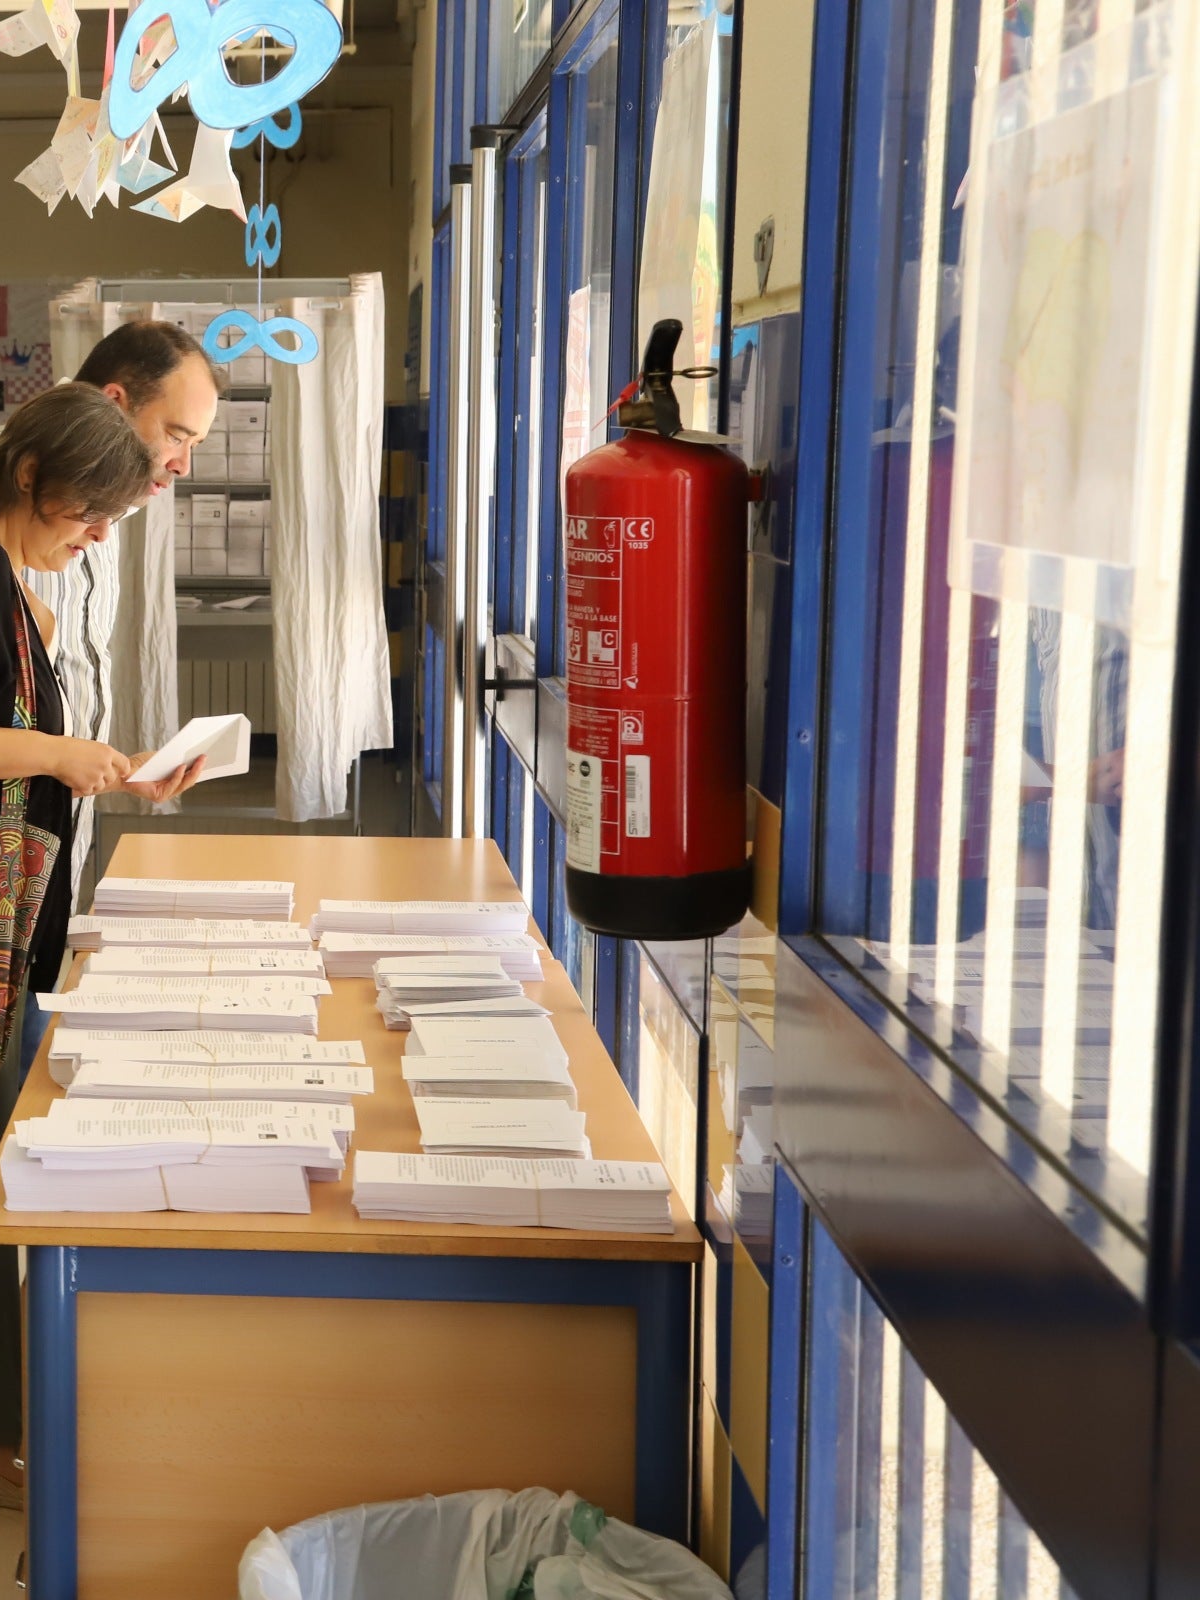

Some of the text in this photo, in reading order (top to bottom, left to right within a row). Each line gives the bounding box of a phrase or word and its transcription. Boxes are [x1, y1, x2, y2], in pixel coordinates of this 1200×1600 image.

[628, 542, 649, 550] 1035
[599, 614, 617, 623] BASE
[604, 632, 614, 646] C
